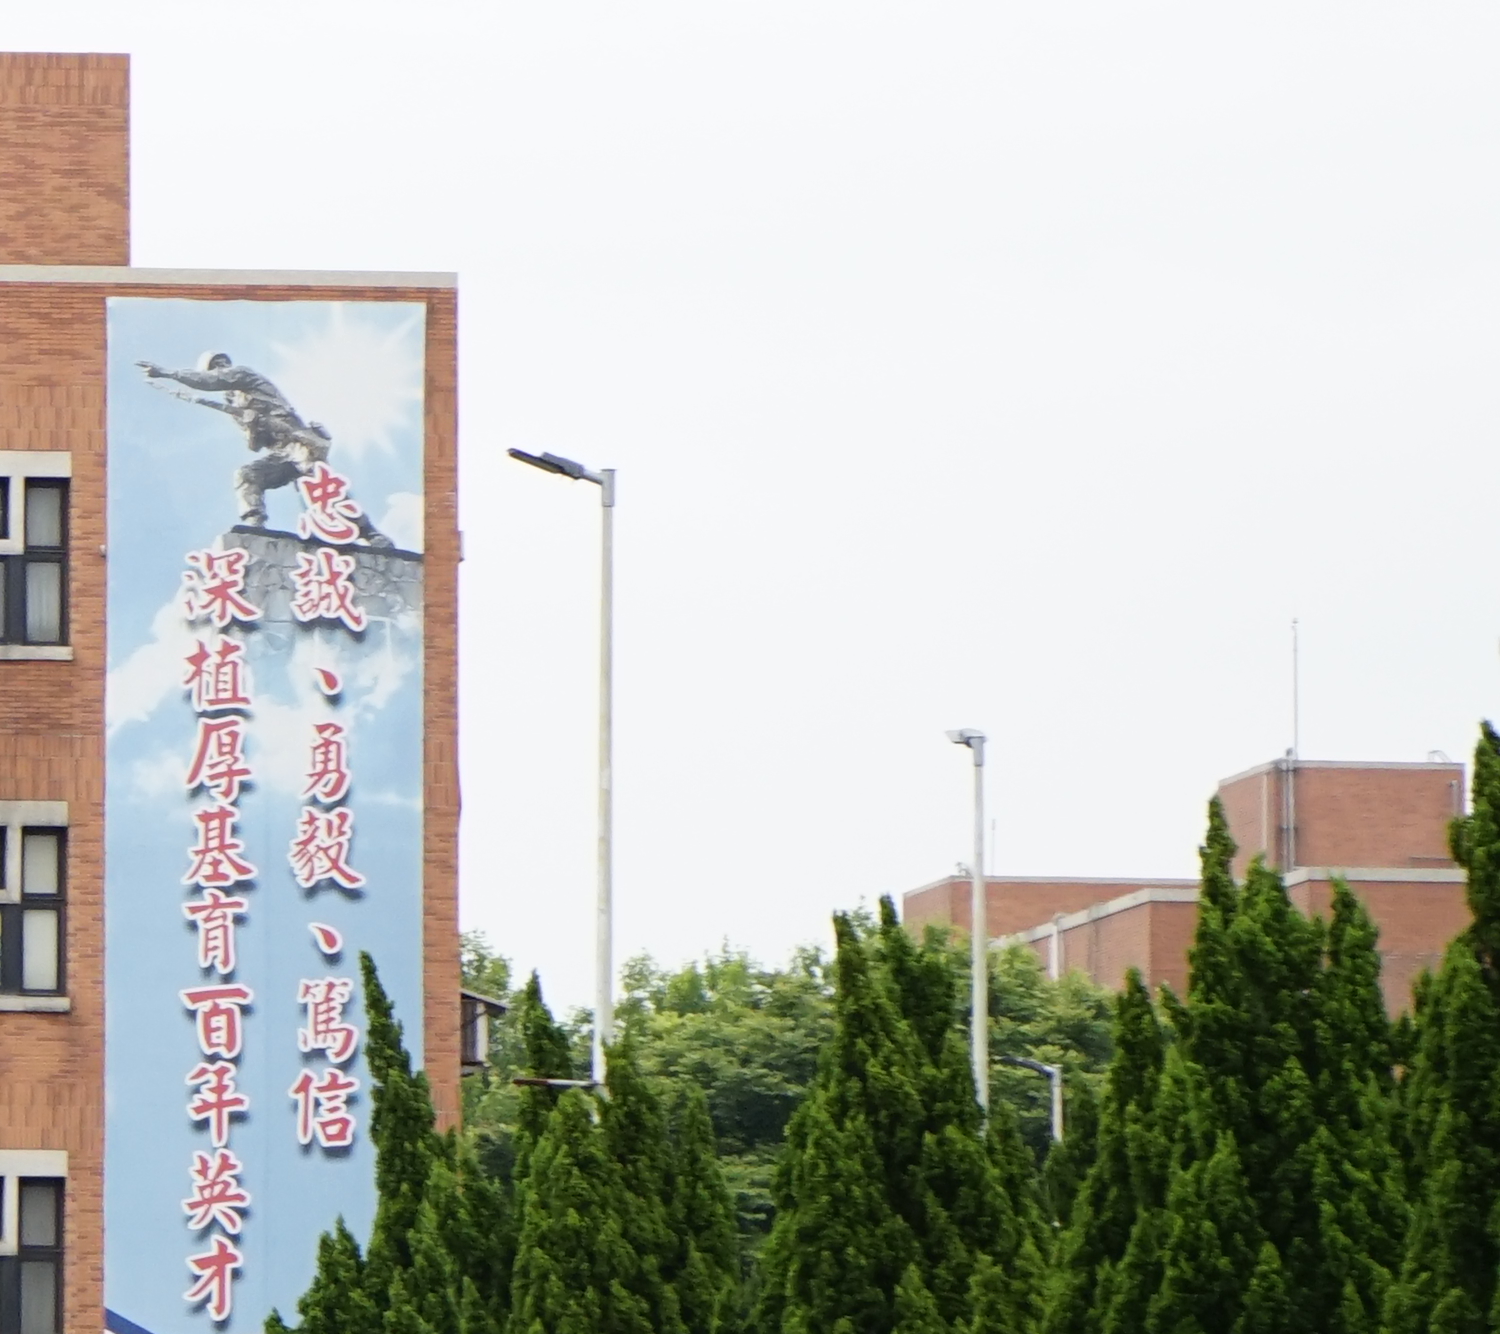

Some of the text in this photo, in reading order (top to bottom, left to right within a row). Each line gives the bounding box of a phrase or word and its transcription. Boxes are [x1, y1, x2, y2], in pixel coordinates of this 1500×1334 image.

[184, 551, 258, 1317] 深植厚基育百年英才
[291, 466, 362, 1144] 忠誠、勇毅、篤信
